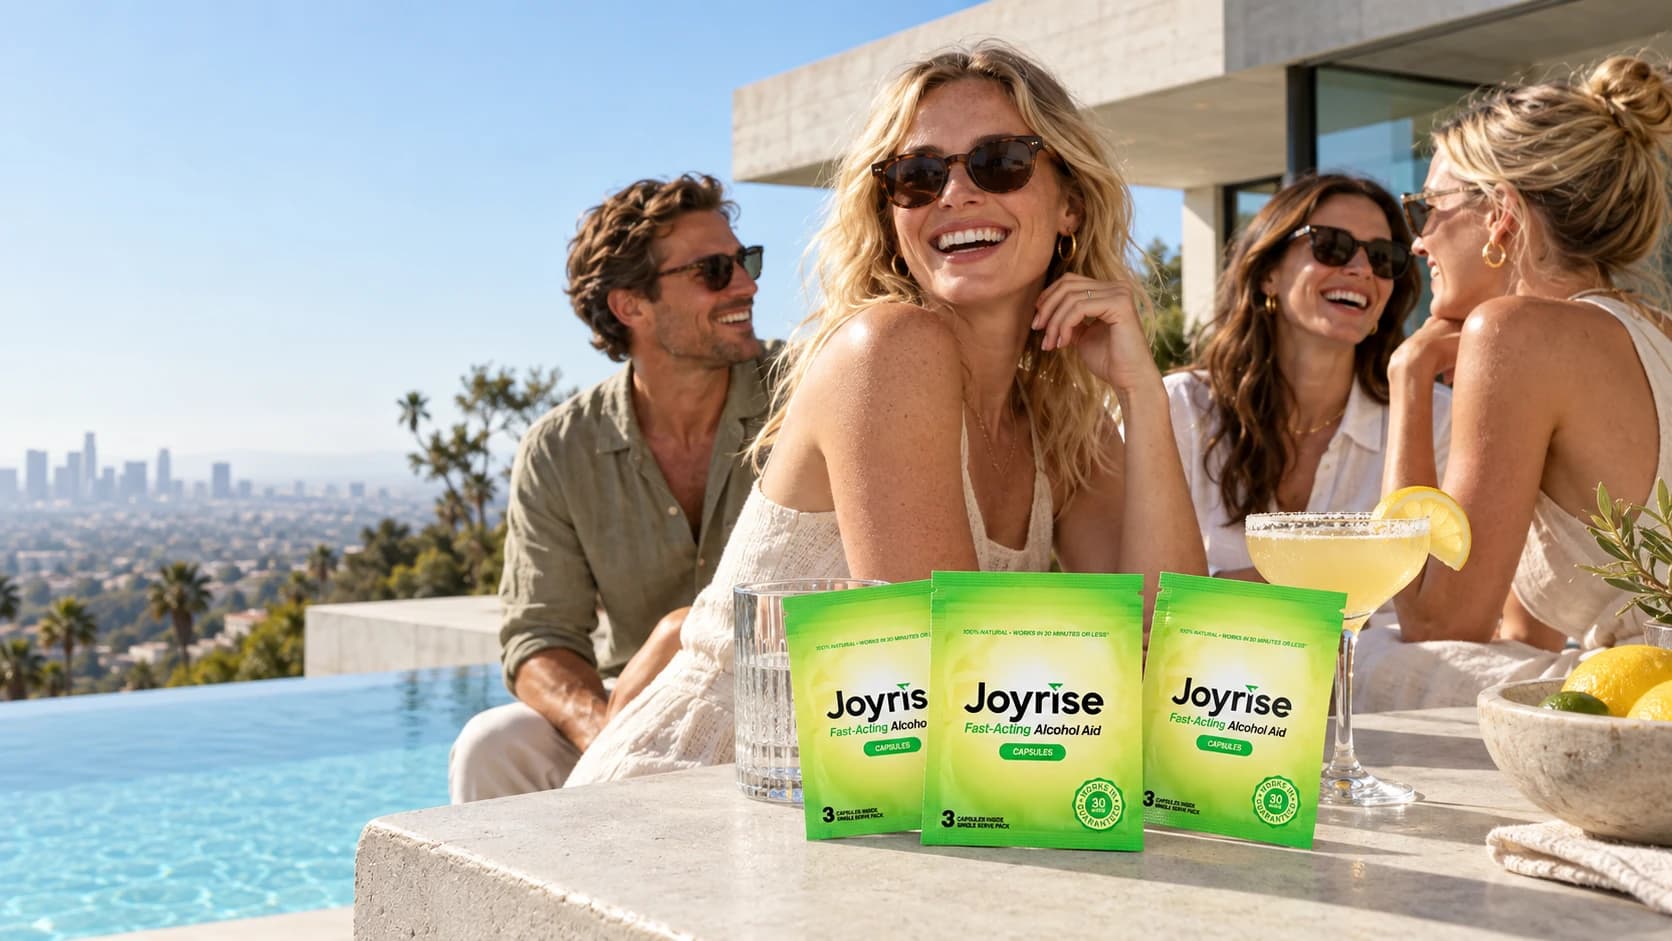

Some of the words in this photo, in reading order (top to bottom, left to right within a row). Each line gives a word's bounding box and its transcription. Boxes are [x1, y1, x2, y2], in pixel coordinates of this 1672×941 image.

[827, 682, 928, 723] Joyris
[964, 682, 1104, 723] Joyrise
[1171, 677, 1292, 718] Joyrise
[830, 724, 888, 737] Fast-Acting
[890, 719, 928, 731] Alcoho
[964, 722, 1031, 737] Fast-Acting
[1034, 724, 1080, 736] Alcohol
[1081, 725, 1102, 736] Aid
[1169, 712, 1226, 731] Fast-Acting
[1227, 720, 1268, 736] Alcohol
[1268, 725, 1286, 738] Aid
[875, 741, 911, 752] CAPSULES
[1013, 747, 1053, 757] CAPSULES
[1207, 740, 1242, 752] CAPSULES
[1080, 783, 1109, 798] WORKS
[1260, 780, 1288, 793] WORKS
[1091, 797, 1106, 808] 30
[1143, 790, 1154, 807] 3
[1270, 793, 1283, 804] 30
[822, 806, 835, 823] 3
[941, 809, 955, 828] 3
[1077, 804, 1120, 828] GUARANTEED
